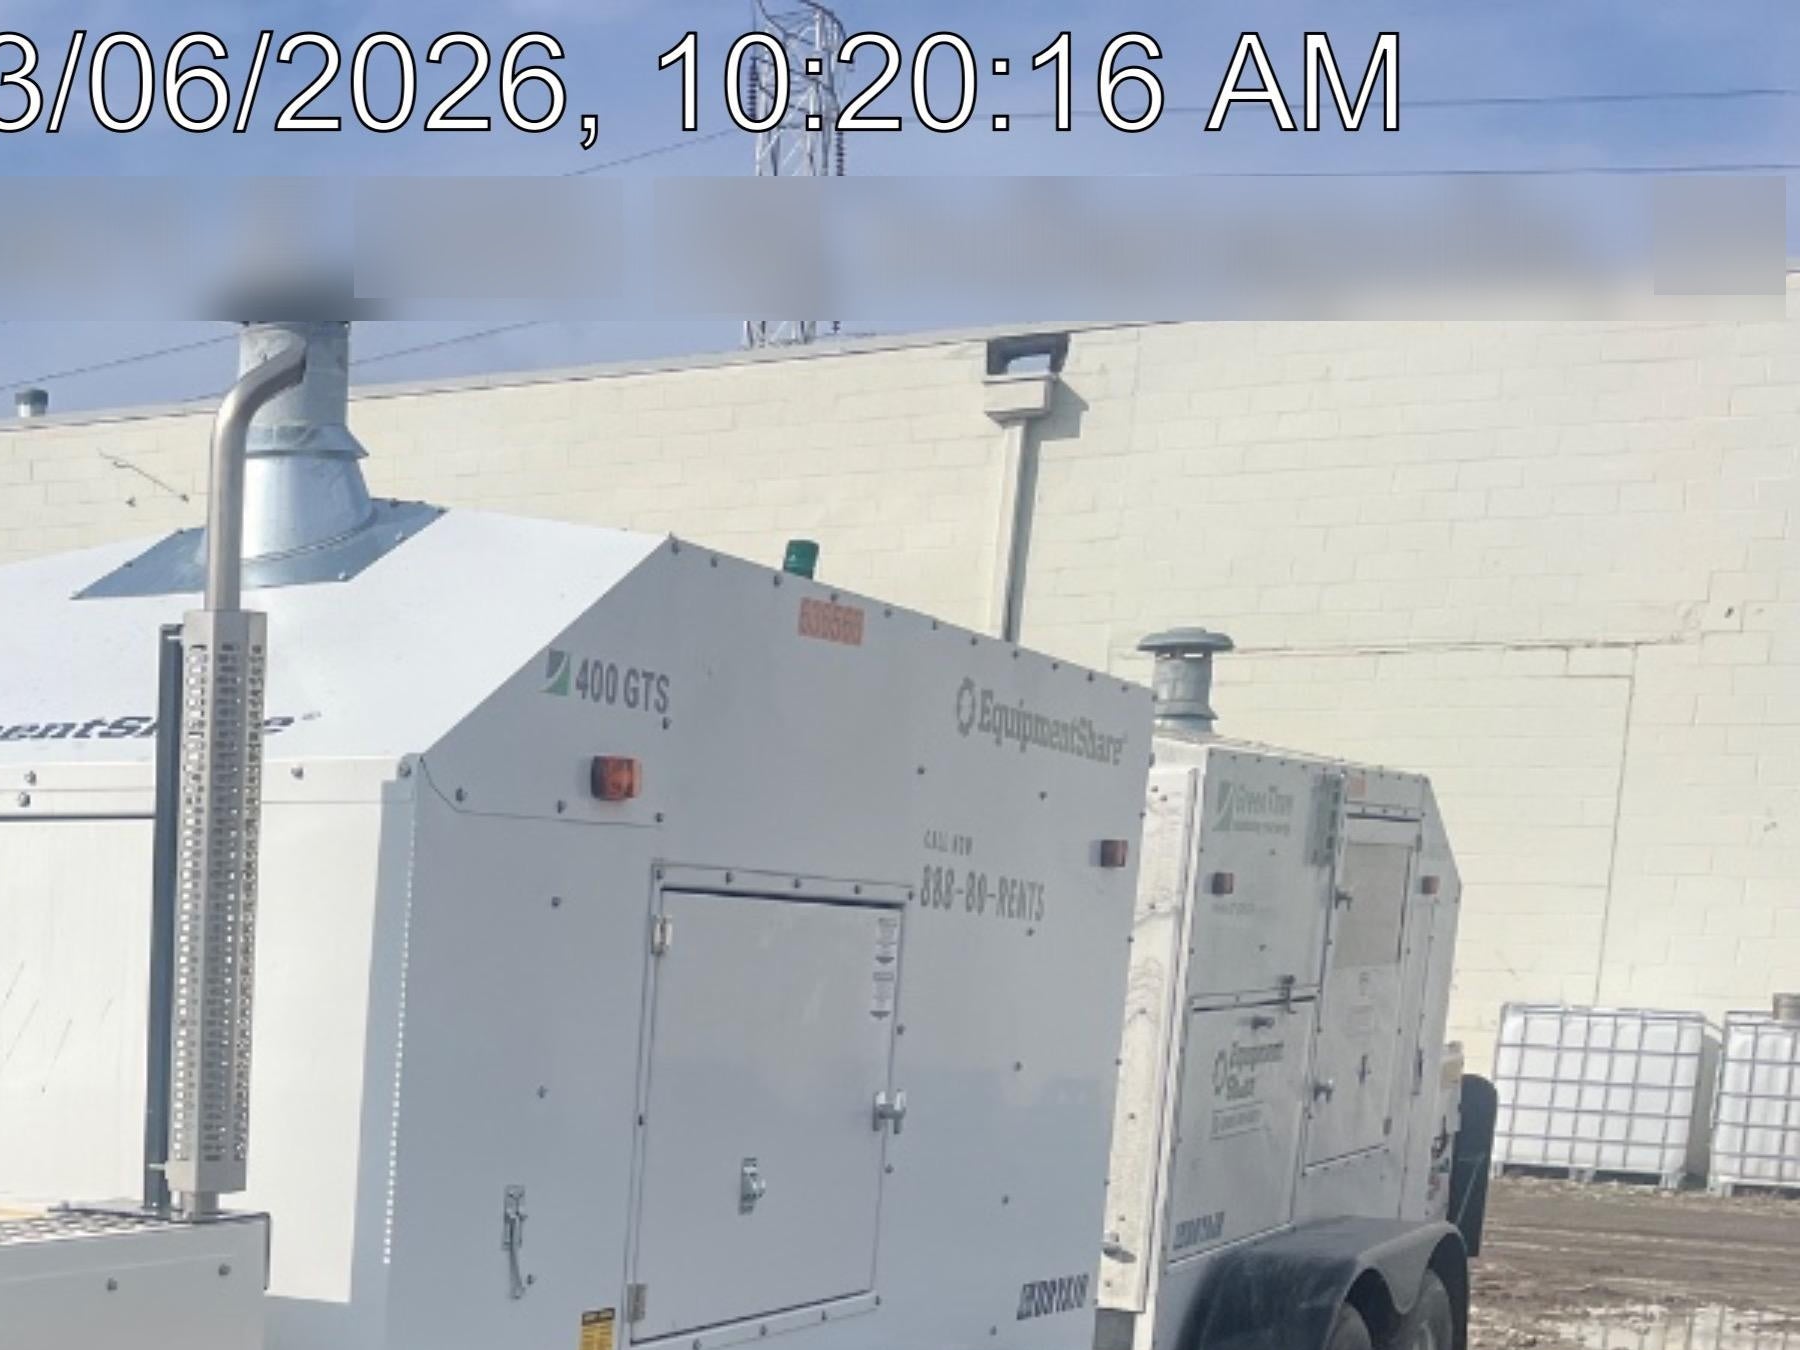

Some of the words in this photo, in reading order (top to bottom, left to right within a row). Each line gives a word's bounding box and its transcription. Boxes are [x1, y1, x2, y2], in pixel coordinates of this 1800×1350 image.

[576, 658, 619, 705] 400
[624, 667, 670, 714] GTS
[978, 688, 1124, 766] EquipmentShare
